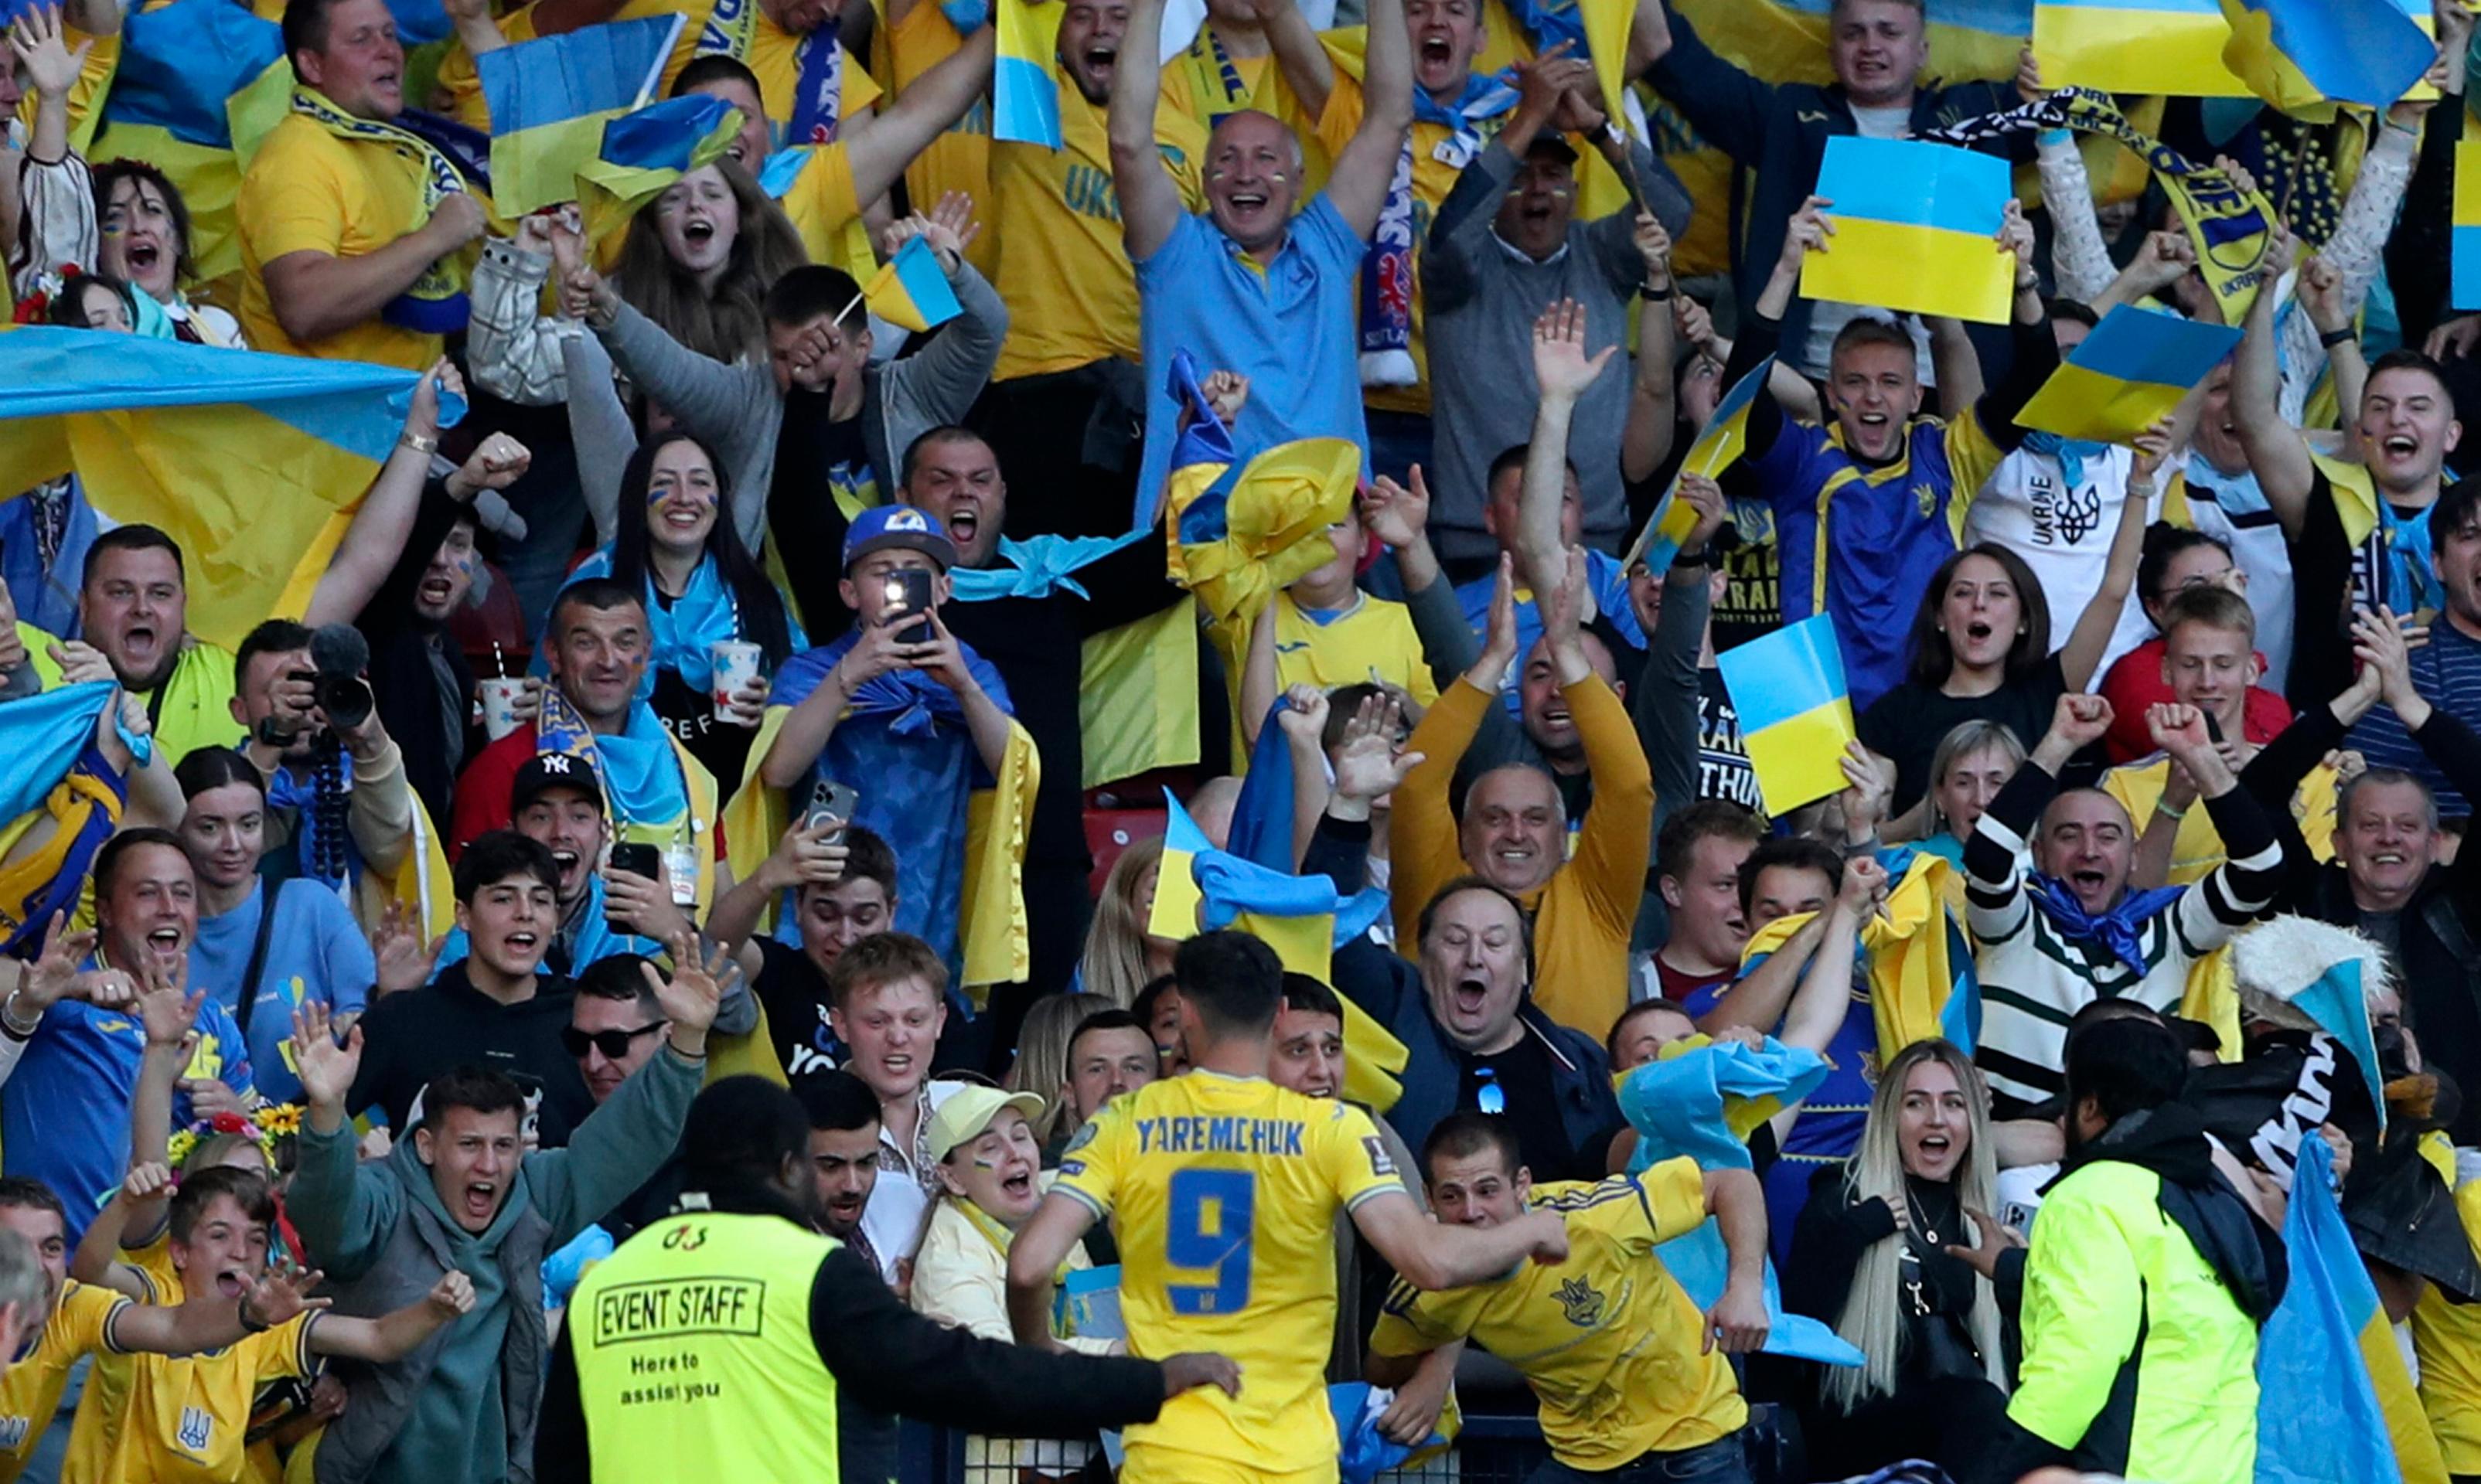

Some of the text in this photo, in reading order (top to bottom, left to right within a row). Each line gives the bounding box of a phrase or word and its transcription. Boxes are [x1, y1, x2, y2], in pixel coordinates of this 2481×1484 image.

[542, 754, 571, 774] NY
[1137, 1116, 1304, 1156] YAREMCHUK
[1166, 1168, 1256, 1314] 9
[603, 1285, 747, 1335] EVENT STAFF
[631, 1353, 698, 1375] Here to
[620, 1382, 721, 1405] assist you
